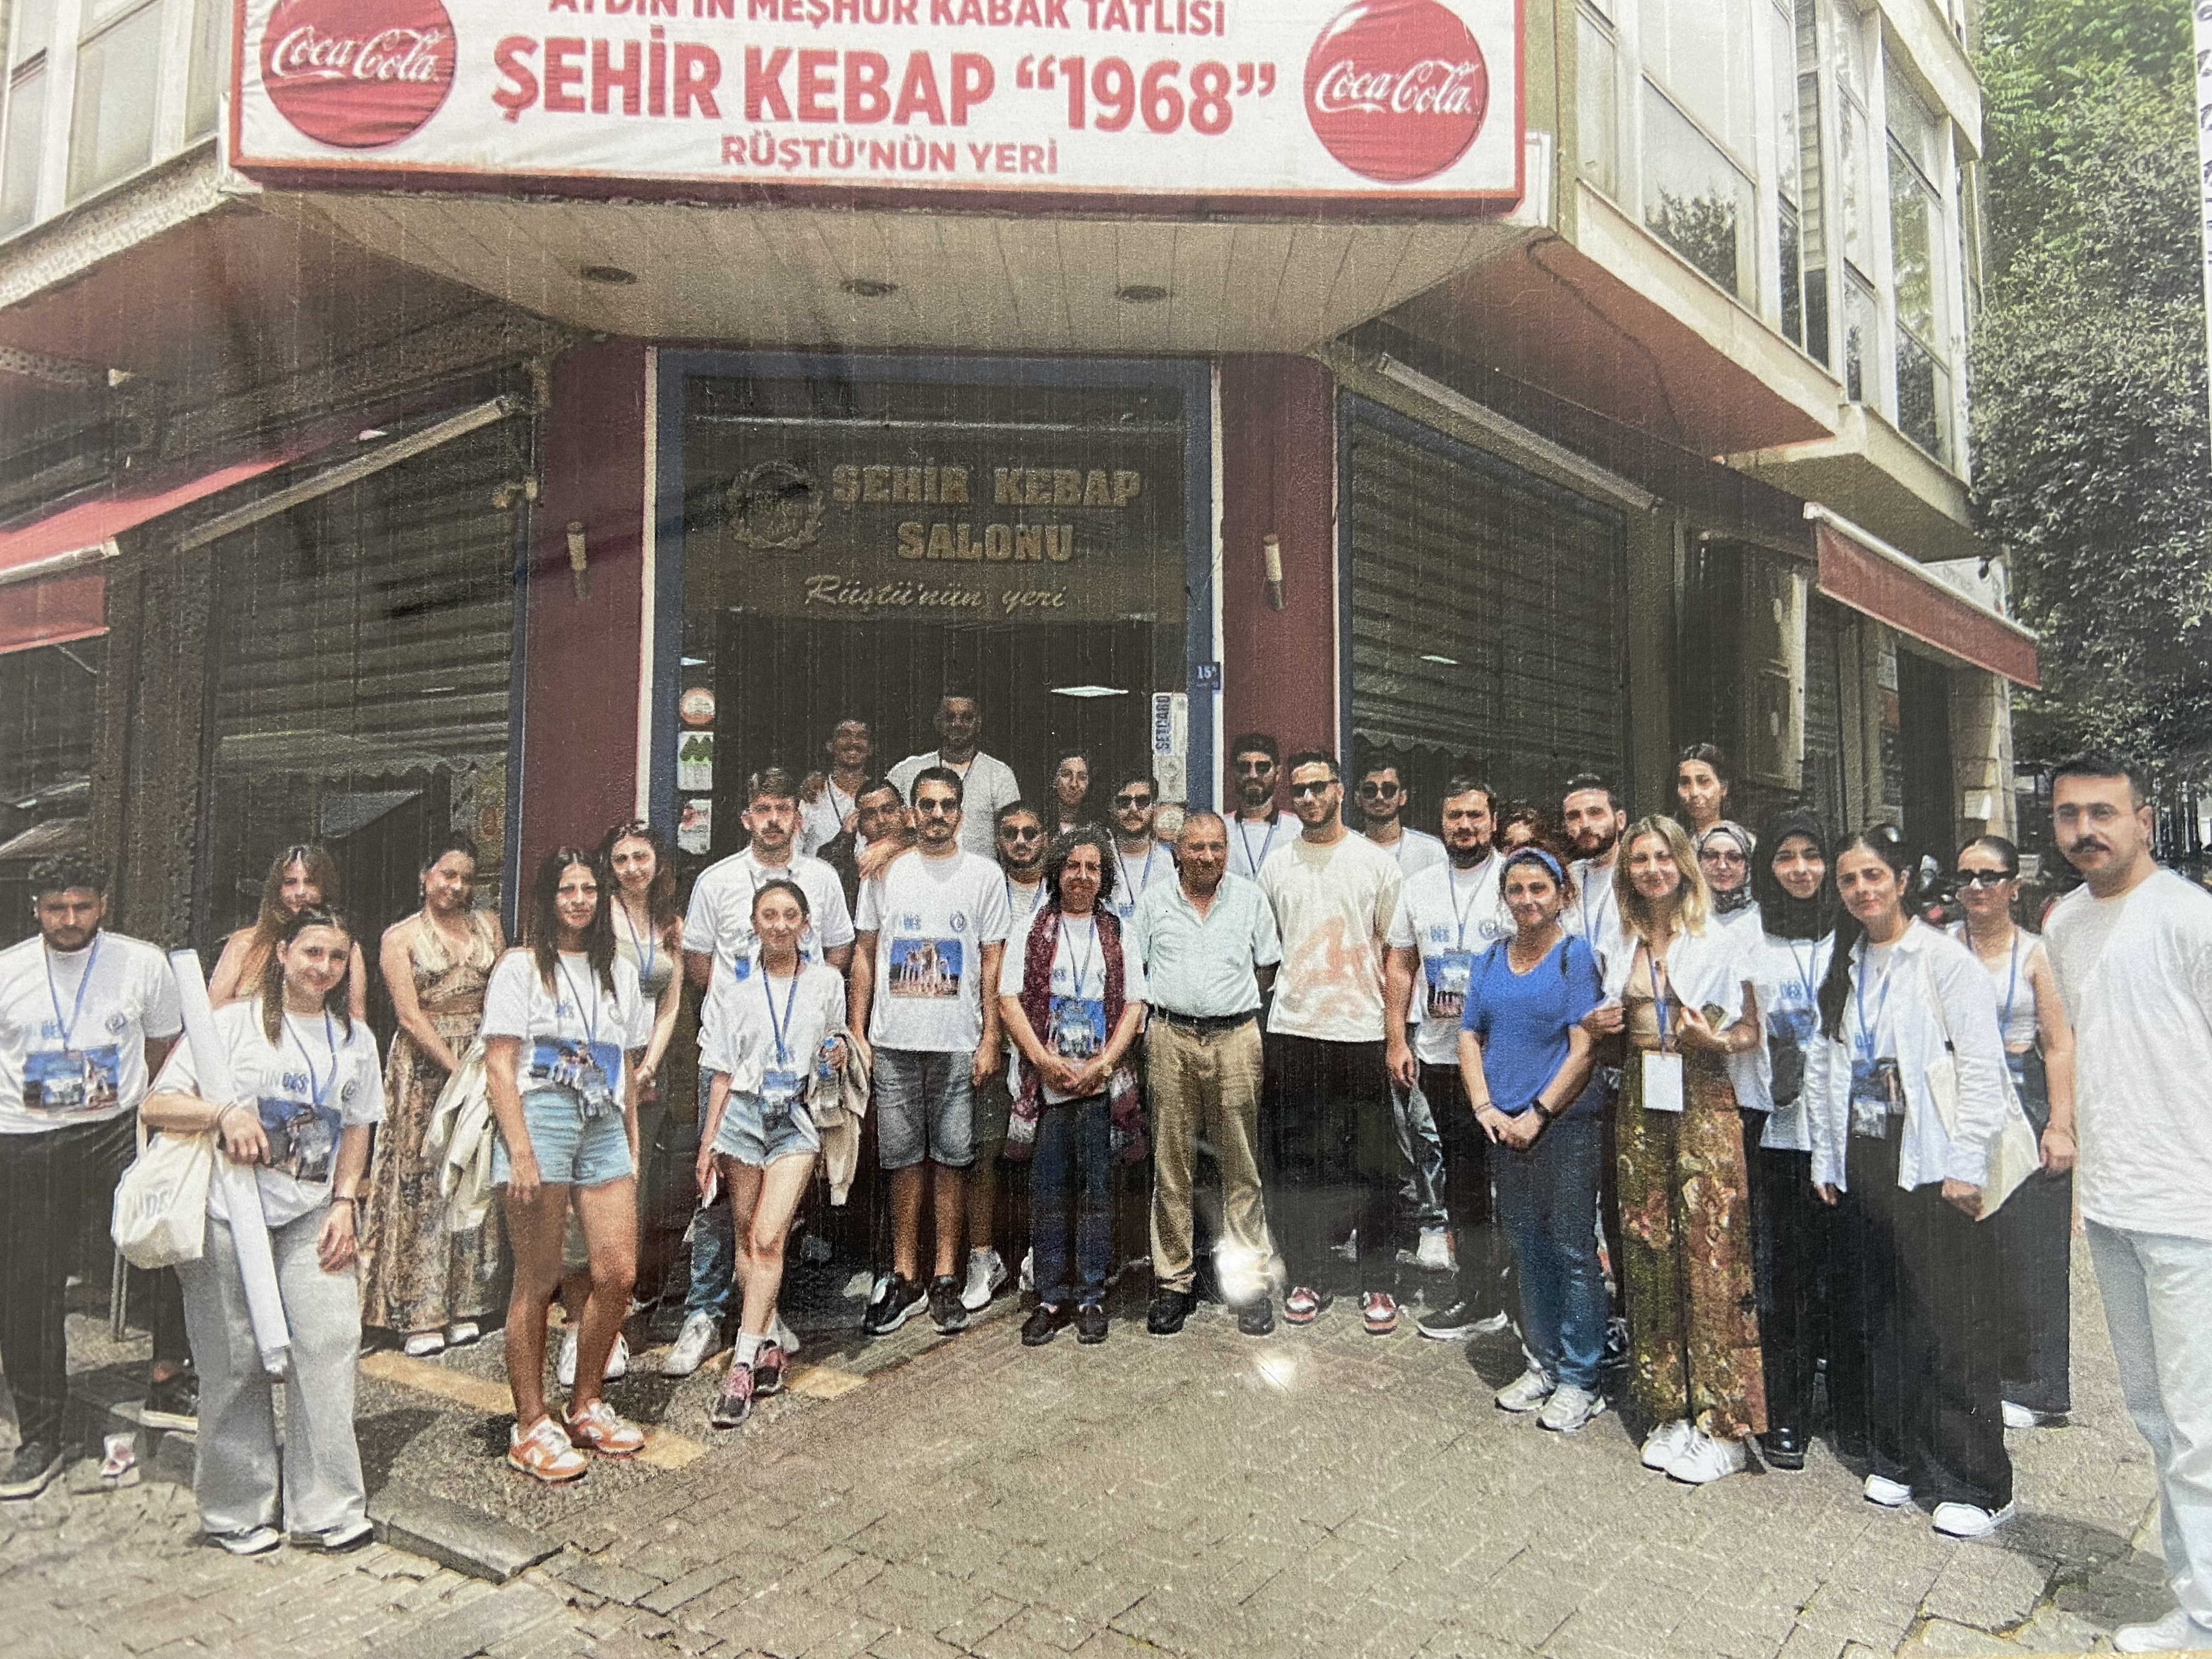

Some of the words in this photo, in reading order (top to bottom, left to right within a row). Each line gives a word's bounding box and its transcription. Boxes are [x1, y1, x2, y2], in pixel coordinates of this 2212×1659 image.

[930, 0, 1070, 29] KABAK
[1081, 0, 1225, 36] TATLISI
[492, 25, 722, 123] ŞEHİR
[743, 47, 996, 126] KEBAP
[720, 130, 956, 172] RÜŞTÜ'NÜN
[969, 138, 1058, 173] YERİ
[993, 466, 1141, 507] KEBAP
[896, 522, 1074, 562] SALONU
[1000, 585, 1066, 613] yeri
